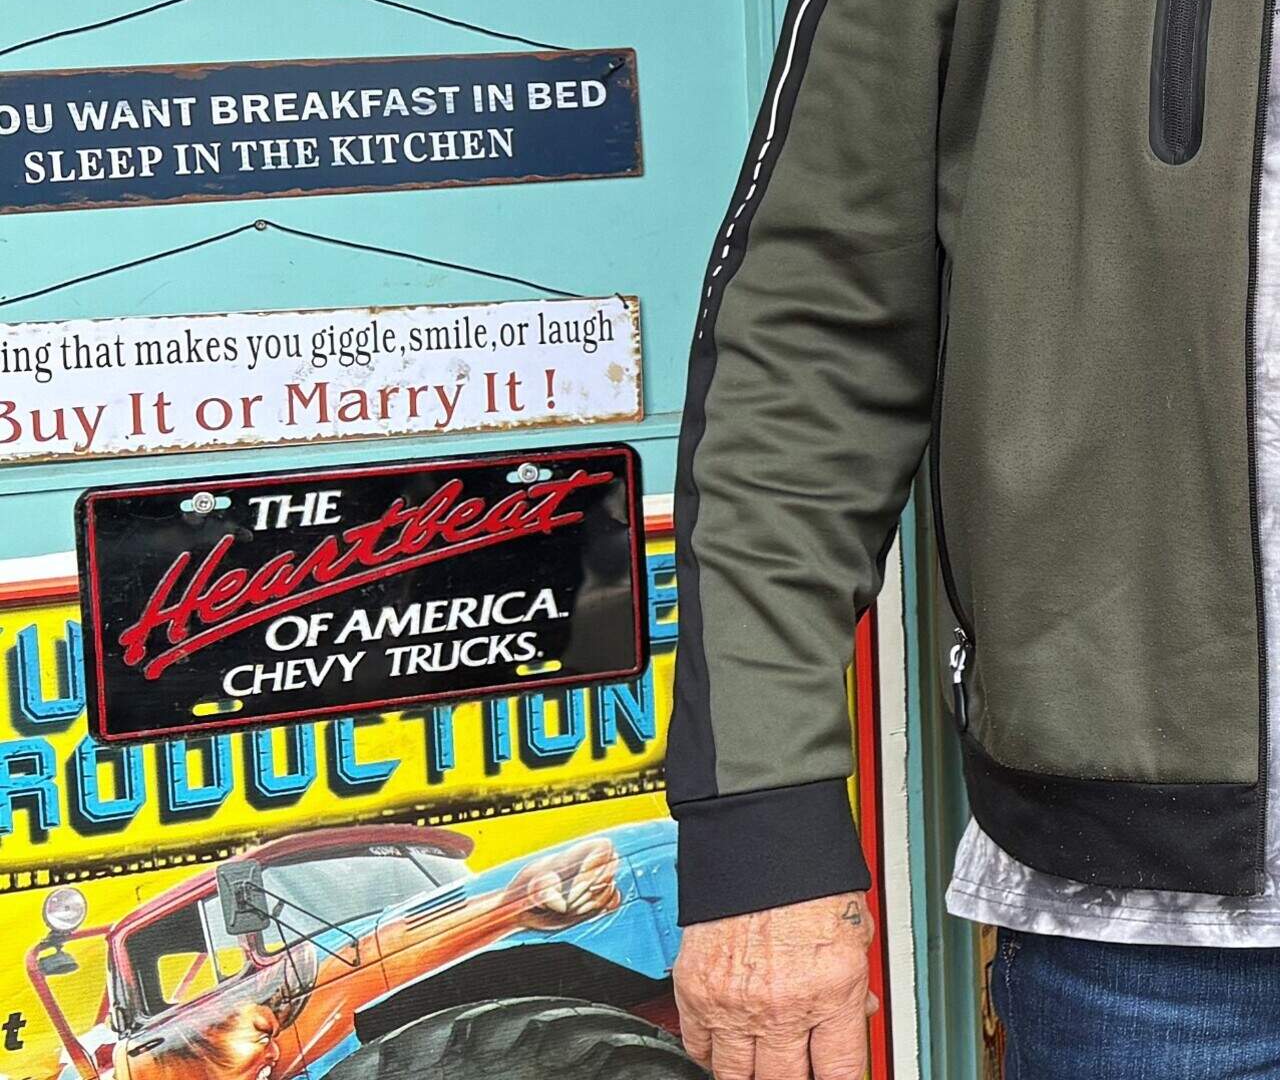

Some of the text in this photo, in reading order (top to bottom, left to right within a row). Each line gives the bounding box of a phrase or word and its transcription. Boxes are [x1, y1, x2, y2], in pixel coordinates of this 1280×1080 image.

[67, 96, 197, 133] WANT
[209, 86, 457, 125] BREAKFAST
[472, 85, 515, 114] IN
[527, 79, 607, 110] BED
[23, 127, 516, 186] SLEEP IN THE KITCHEN
[60, 333, 126, 370] that
[134, 328, 238, 366] makes
[247, 331, 302, 370] you
[538, 308, 614, 347] laugh
[0, 400, 107, 452] Buy
[128, 391, 175, 435] It
[195, 395, 263, 431] or
[285, 375, 466, 433] Marry
[484, 371, 526, 415] It
[250, 489, 342, 532] THE
[119, 473, 613, 680] Heartbeat
[266, 614, 329, 652] OF
[223, 630, 543, 697] CHEVY TRUCKS.
